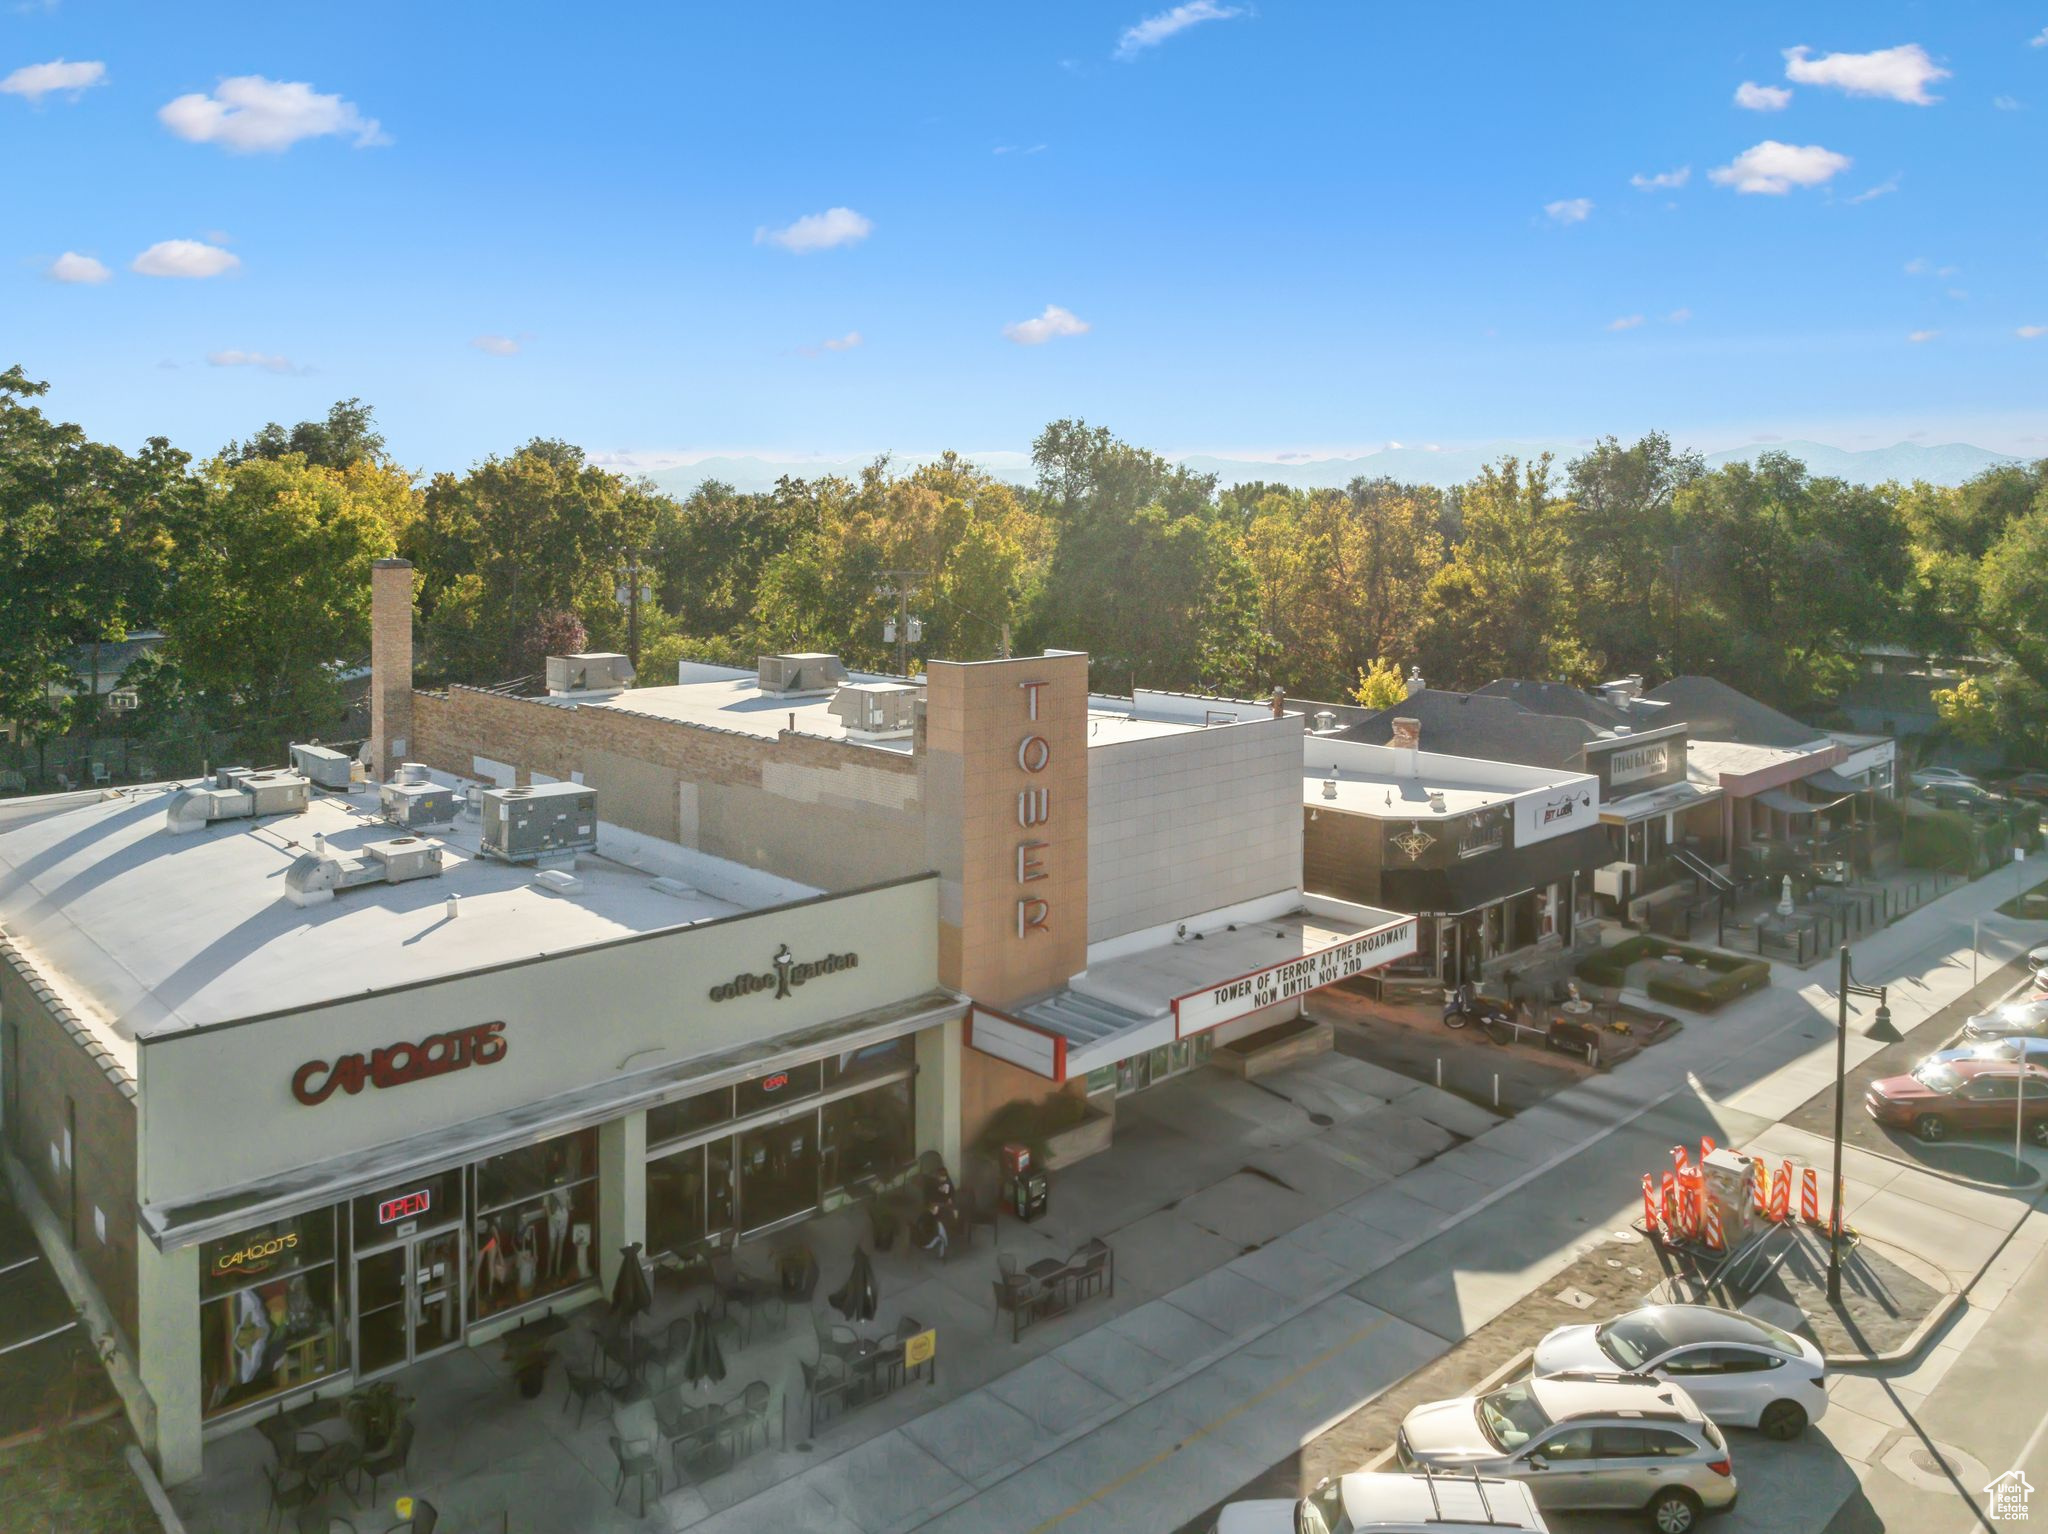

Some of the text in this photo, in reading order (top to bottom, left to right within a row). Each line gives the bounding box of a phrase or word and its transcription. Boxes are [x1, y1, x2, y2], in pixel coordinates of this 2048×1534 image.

[1018, 681, 1050, 938] TOWER
[709, 952, 859, 1003] coffee garden
[1214, 980, 1251, 1005] TOWER
[1257, 973, 1270, 989] OF
[1276, 958, 1316, 984] TERROR
[1321, 952, 1333, 969] AT
[1336, 944, 1353, 962] THE
[1254, 987, 1278, 1008] NOW
[1283, 975, 1313, 998] UNTIL
[1319, 965, 1338, 985] NOV
[291, 1020, 508, 1107] CAHOOTS
[381, 1193, 428, 1221] OPEN
[219, 1233, 298, 1268] CAHOOTS
